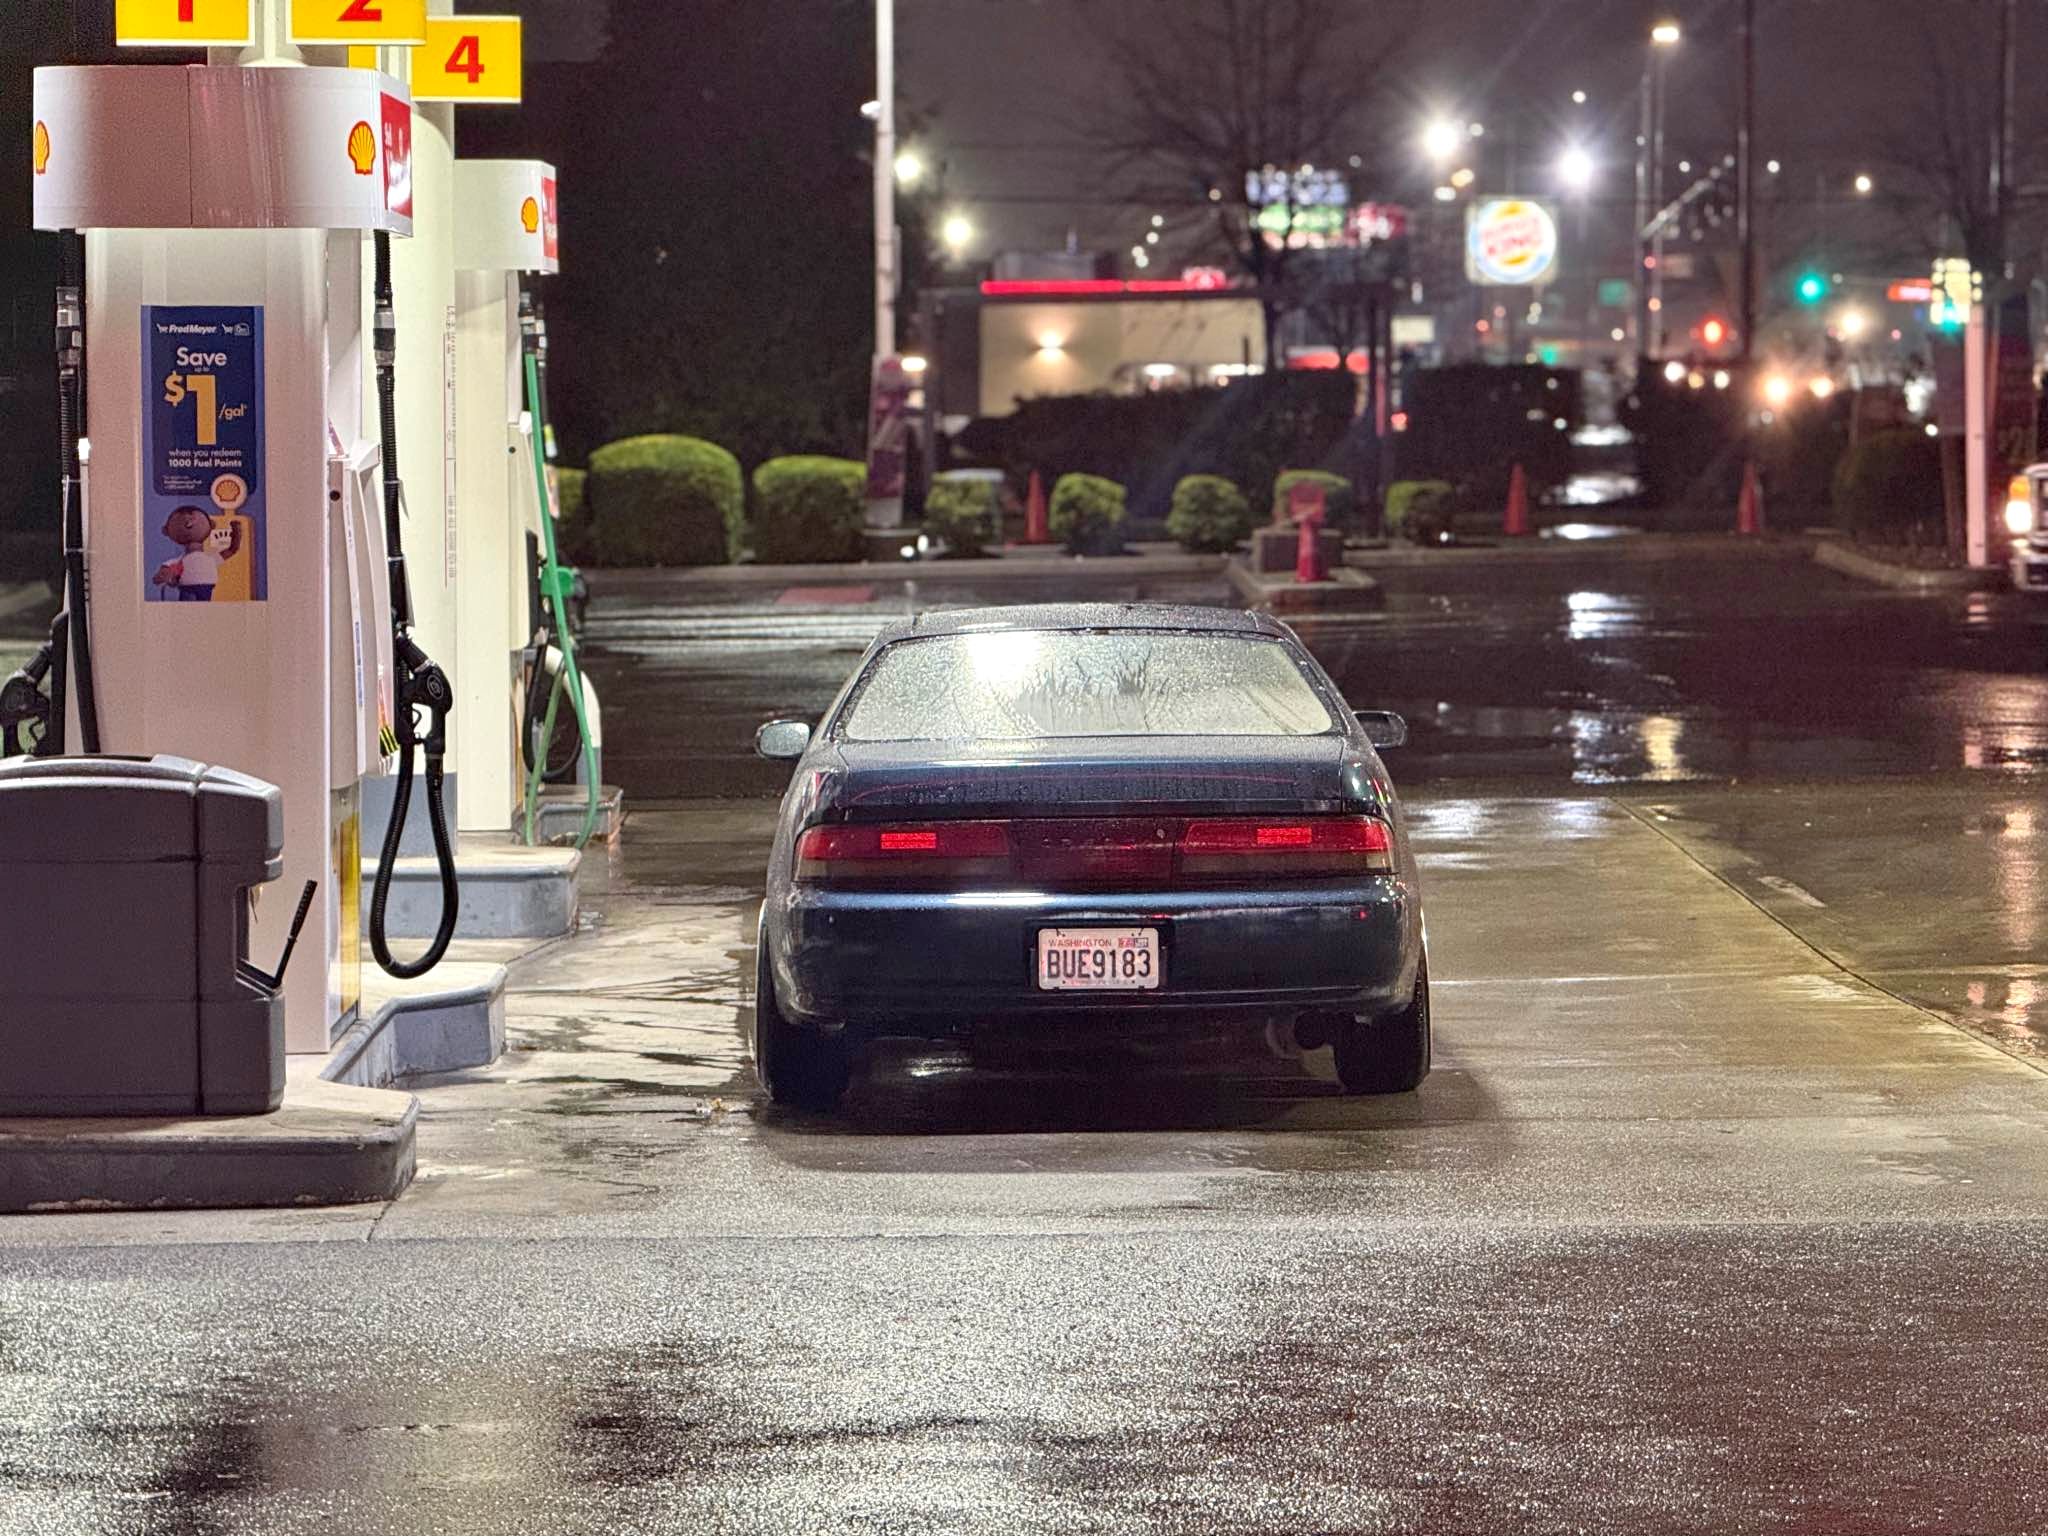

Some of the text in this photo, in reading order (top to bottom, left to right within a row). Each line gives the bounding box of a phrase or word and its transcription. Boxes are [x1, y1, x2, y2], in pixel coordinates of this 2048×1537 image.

[444, 35, 485, 84] 4
[177, 346, 227, 367] Save
[168, 447, 242, 458] when you redeem
[168, 458, 242, 467] 1000 Fuel Points
[1048, 938, 1112, 947] WASHINGTON
[1047, 949, 1151, 979] BUE9183
